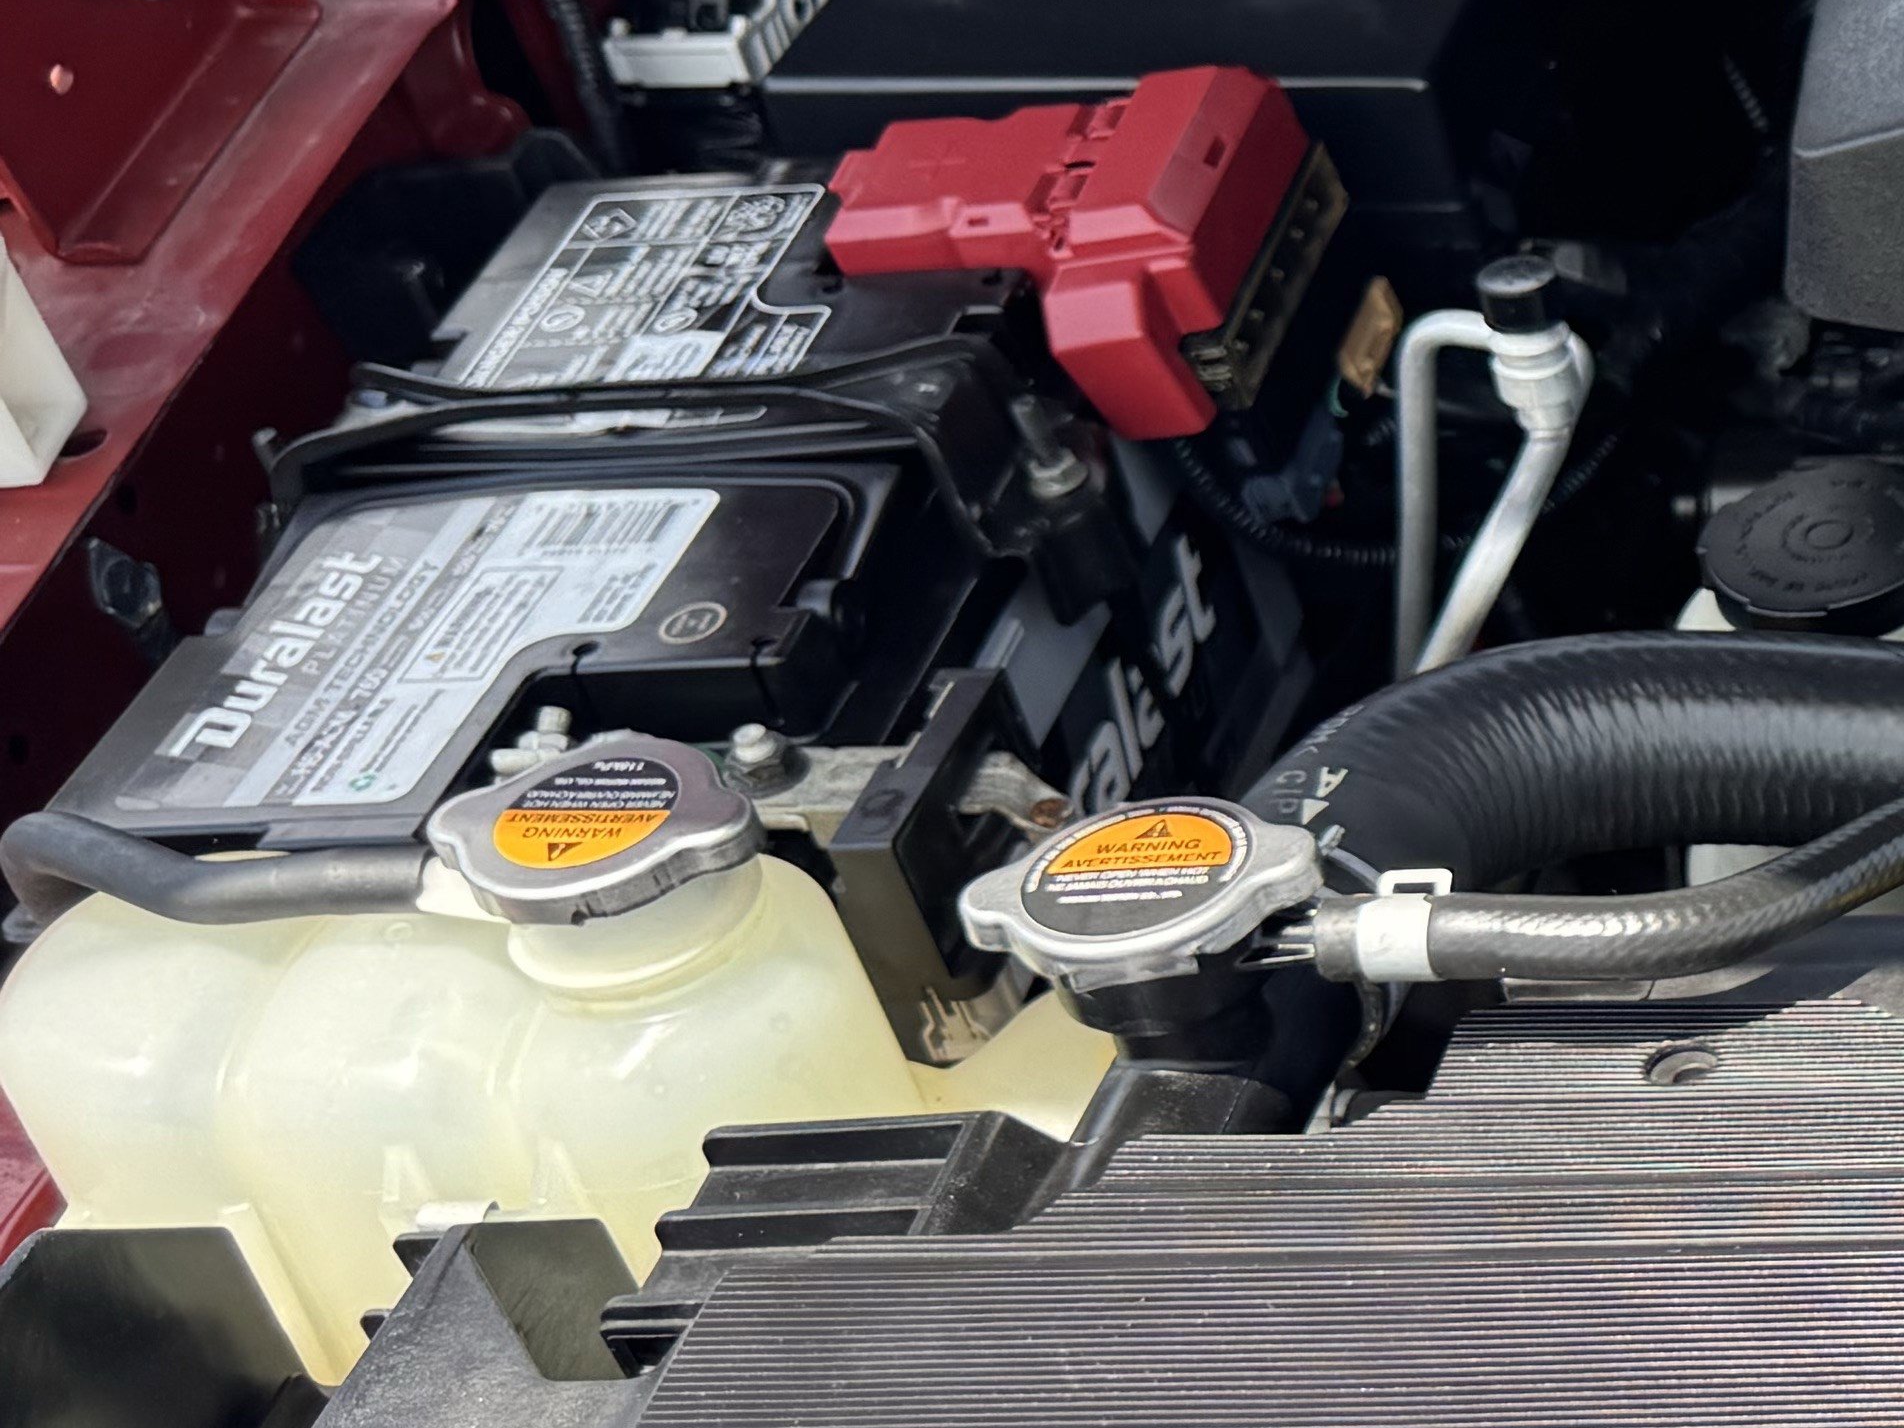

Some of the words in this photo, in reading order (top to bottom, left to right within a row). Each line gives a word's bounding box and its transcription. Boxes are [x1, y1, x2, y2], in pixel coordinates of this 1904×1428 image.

[301, 556, 406, 675] PLATINUM
[323, 561, 439, 692] TECHNOLOGY
[168, 552, 384, 758] Duralast
[508, 813, 658, 823] AVERTISSEMENT
[522, 826, 622, 838] WARNING
[1097, 839, 1202, 854] WARNING
[1061, 851, 1223, 869] AVERTISSEMENT
